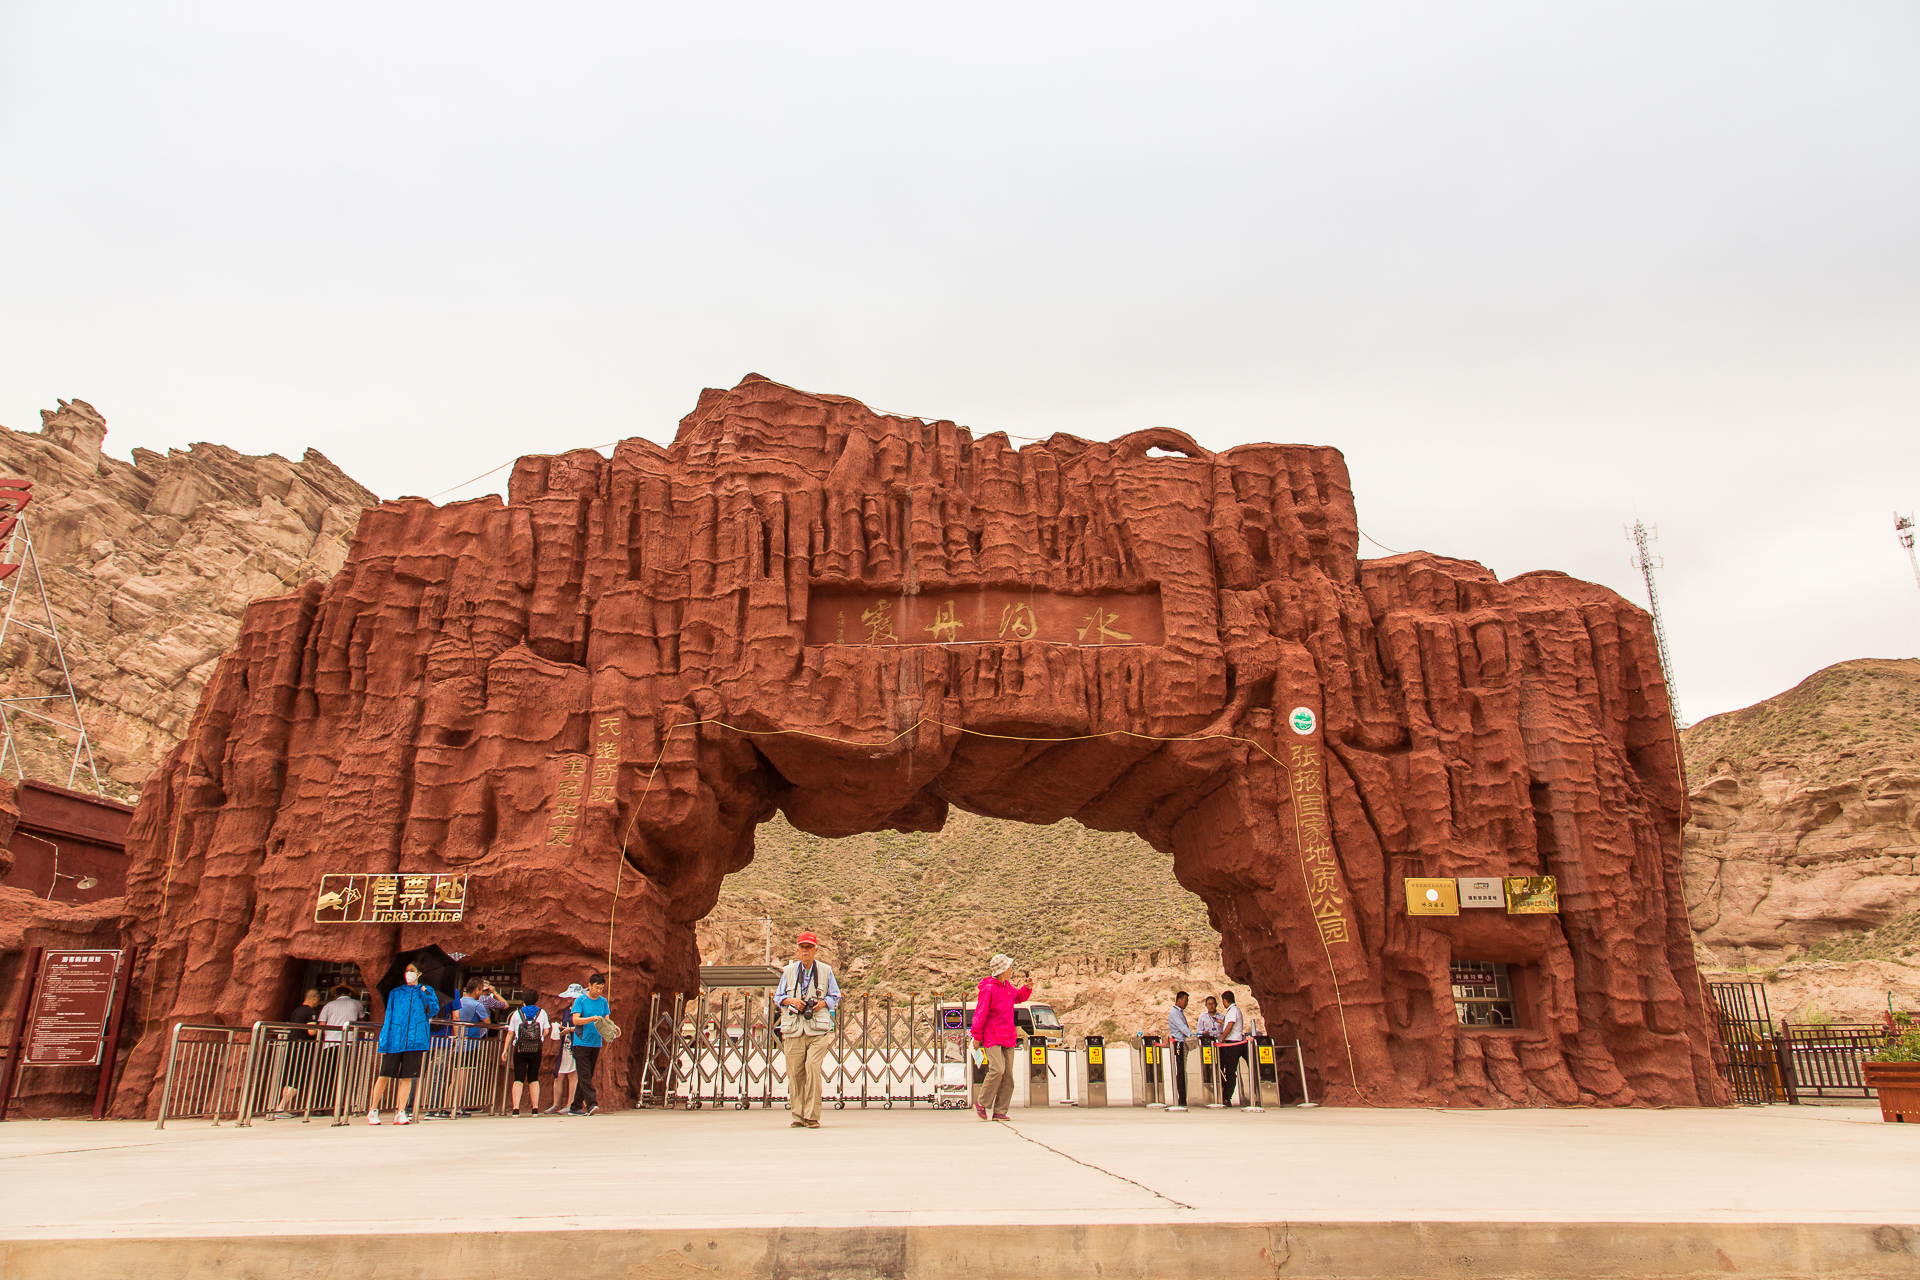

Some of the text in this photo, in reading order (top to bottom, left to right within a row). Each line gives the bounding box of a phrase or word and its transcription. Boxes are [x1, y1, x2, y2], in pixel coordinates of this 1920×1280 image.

[589, 716, 621, 803] 天造奇观
[546, 759, 587, 848] 美冠华夏
[1290, 744, 1349, 944] 张掖国家地质公园
[370, 875, 465, 906] 售票处
[372, 909, 461, 922] Ticket office
